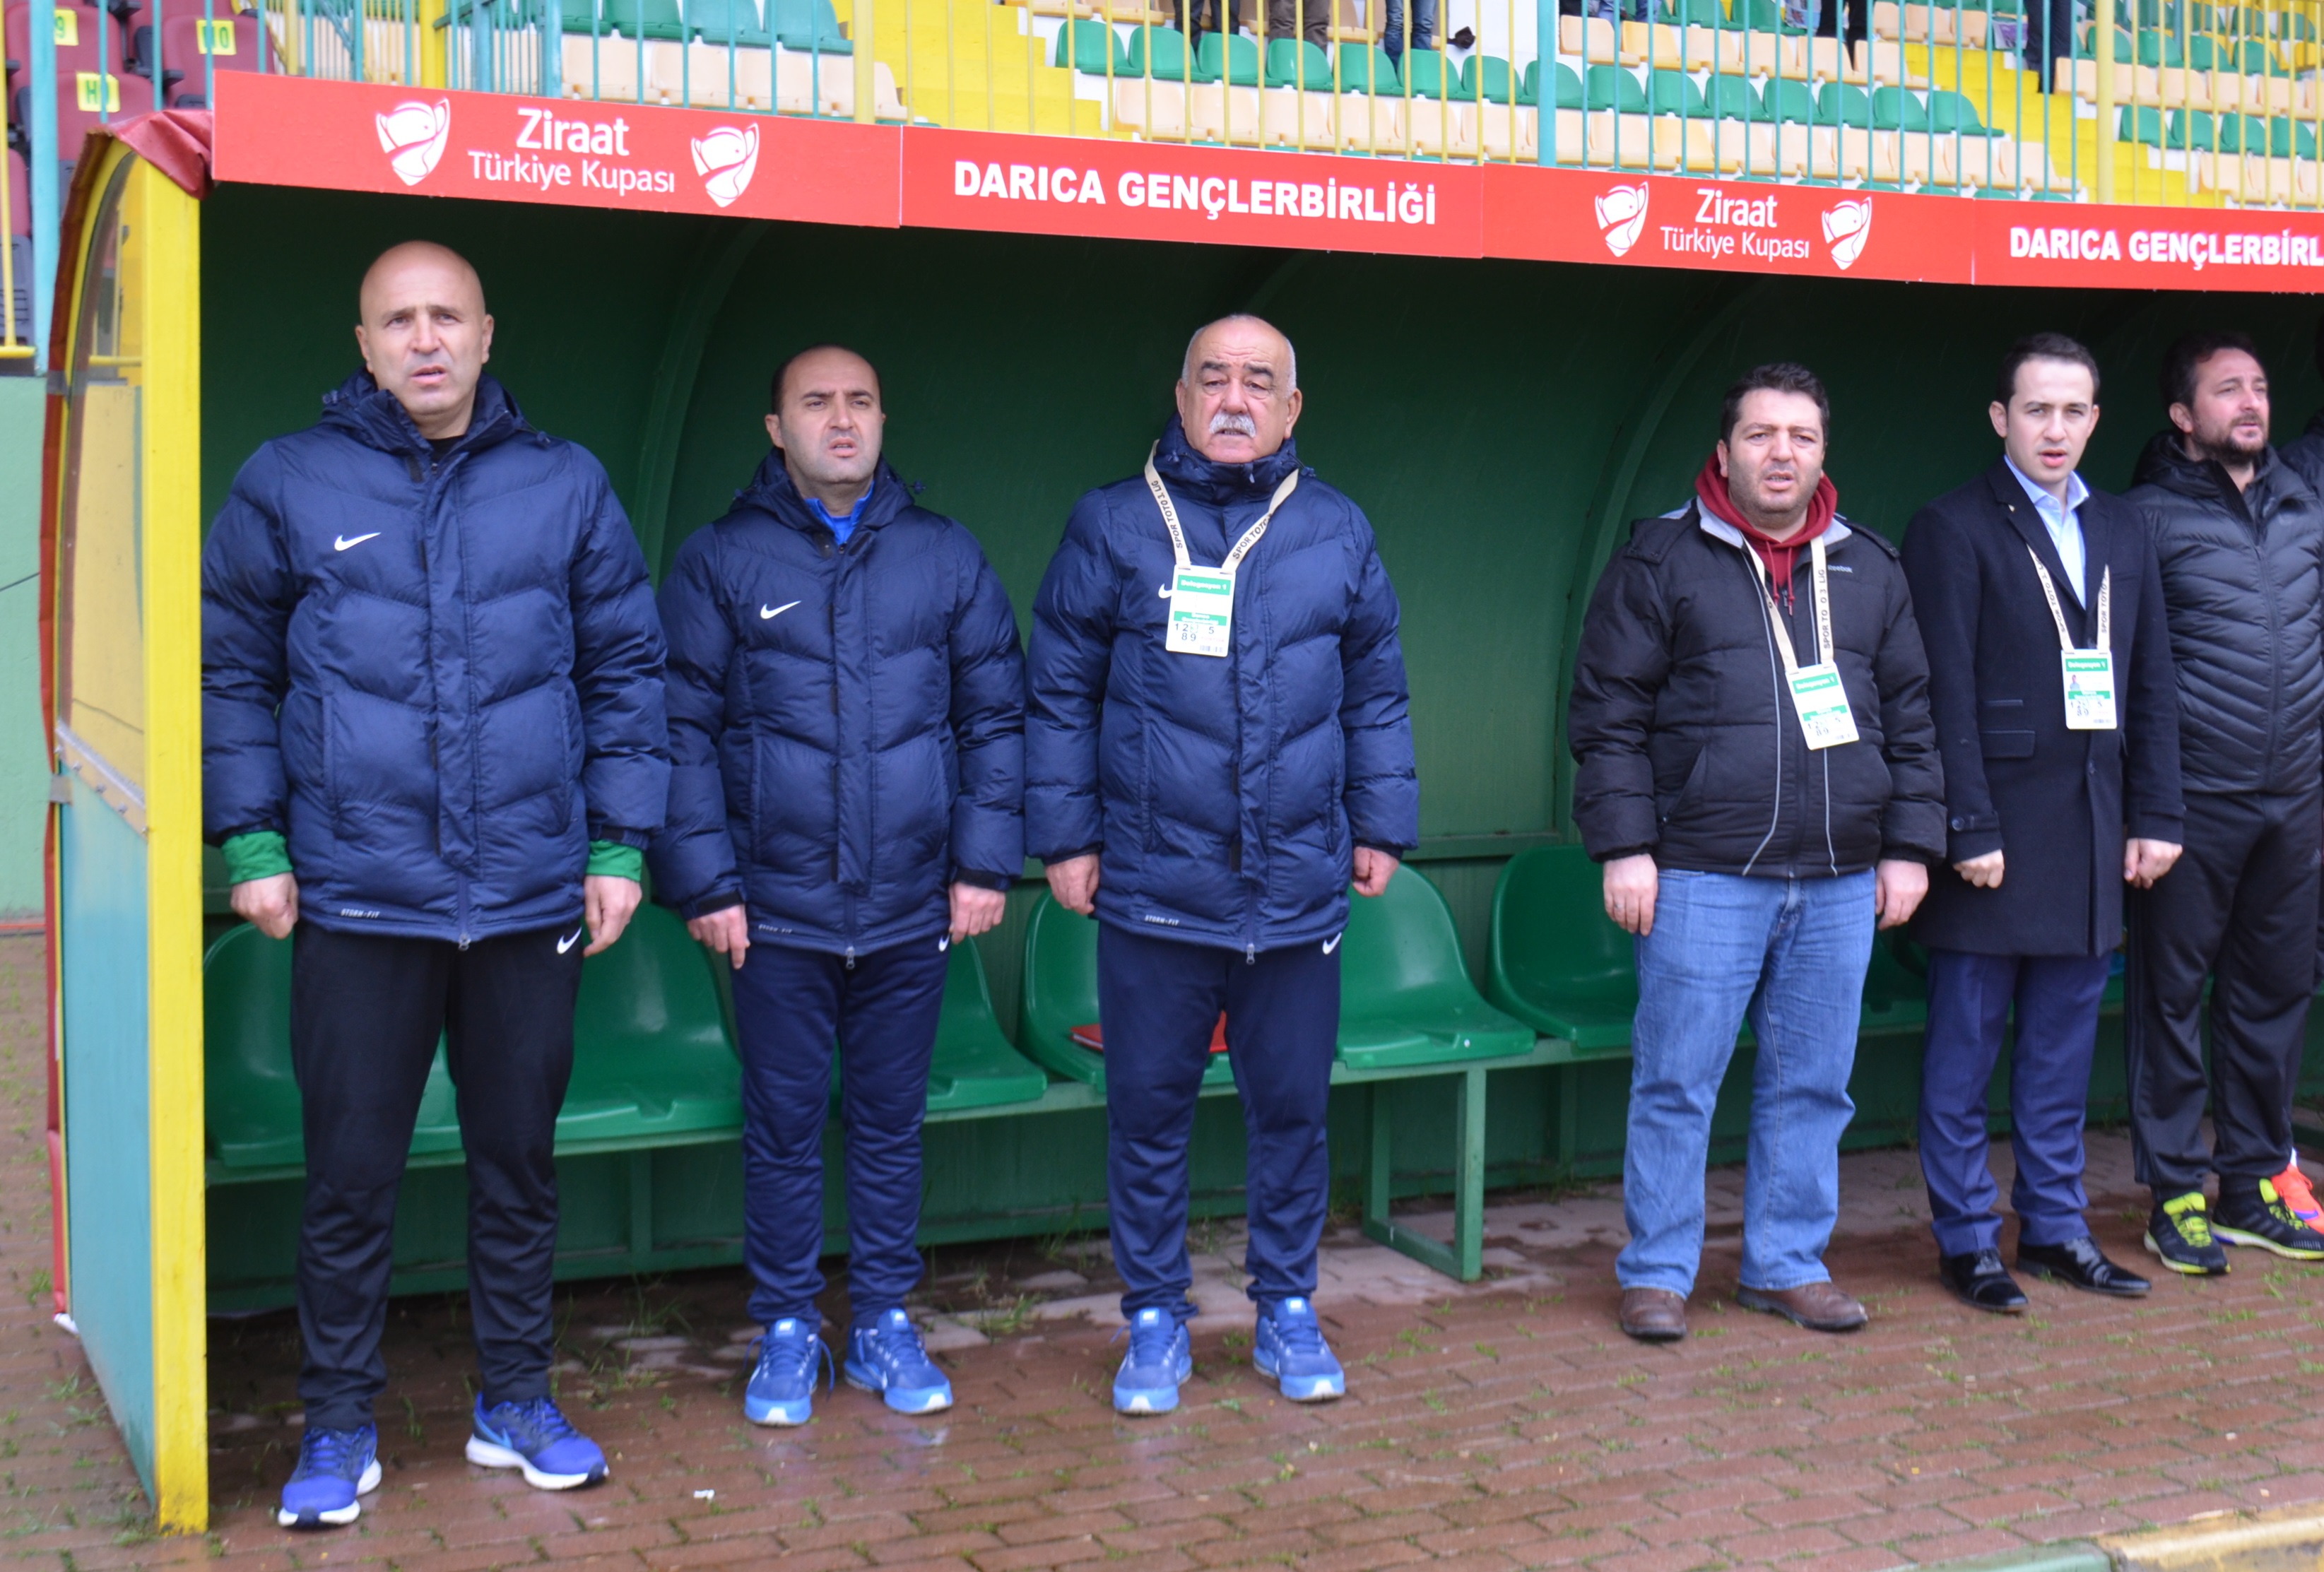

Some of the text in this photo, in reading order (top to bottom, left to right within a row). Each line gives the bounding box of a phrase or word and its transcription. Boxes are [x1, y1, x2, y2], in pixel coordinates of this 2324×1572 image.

[517, 108, 630, 156] Ziraat
[468, 151, 675, 197] Türkiye Kupası
[955, 161, 1436, 225] DARICA GENÇLERBİRLİĞİ
[1696, 188, 1778, 228] Ziraat
[1660, 226, 1810, 263] Türkiye Kupası
[2010, 227, 2121, 261] DARICA
[1160, 500, 1174, 523] TOTO
[1169, 524, 1183, 548] SPOR
[1232, 536, 1252, 560] SPOR
[1208, 626, 1215, 634] 5
[1822, 625, 1831, 649] SPOR
